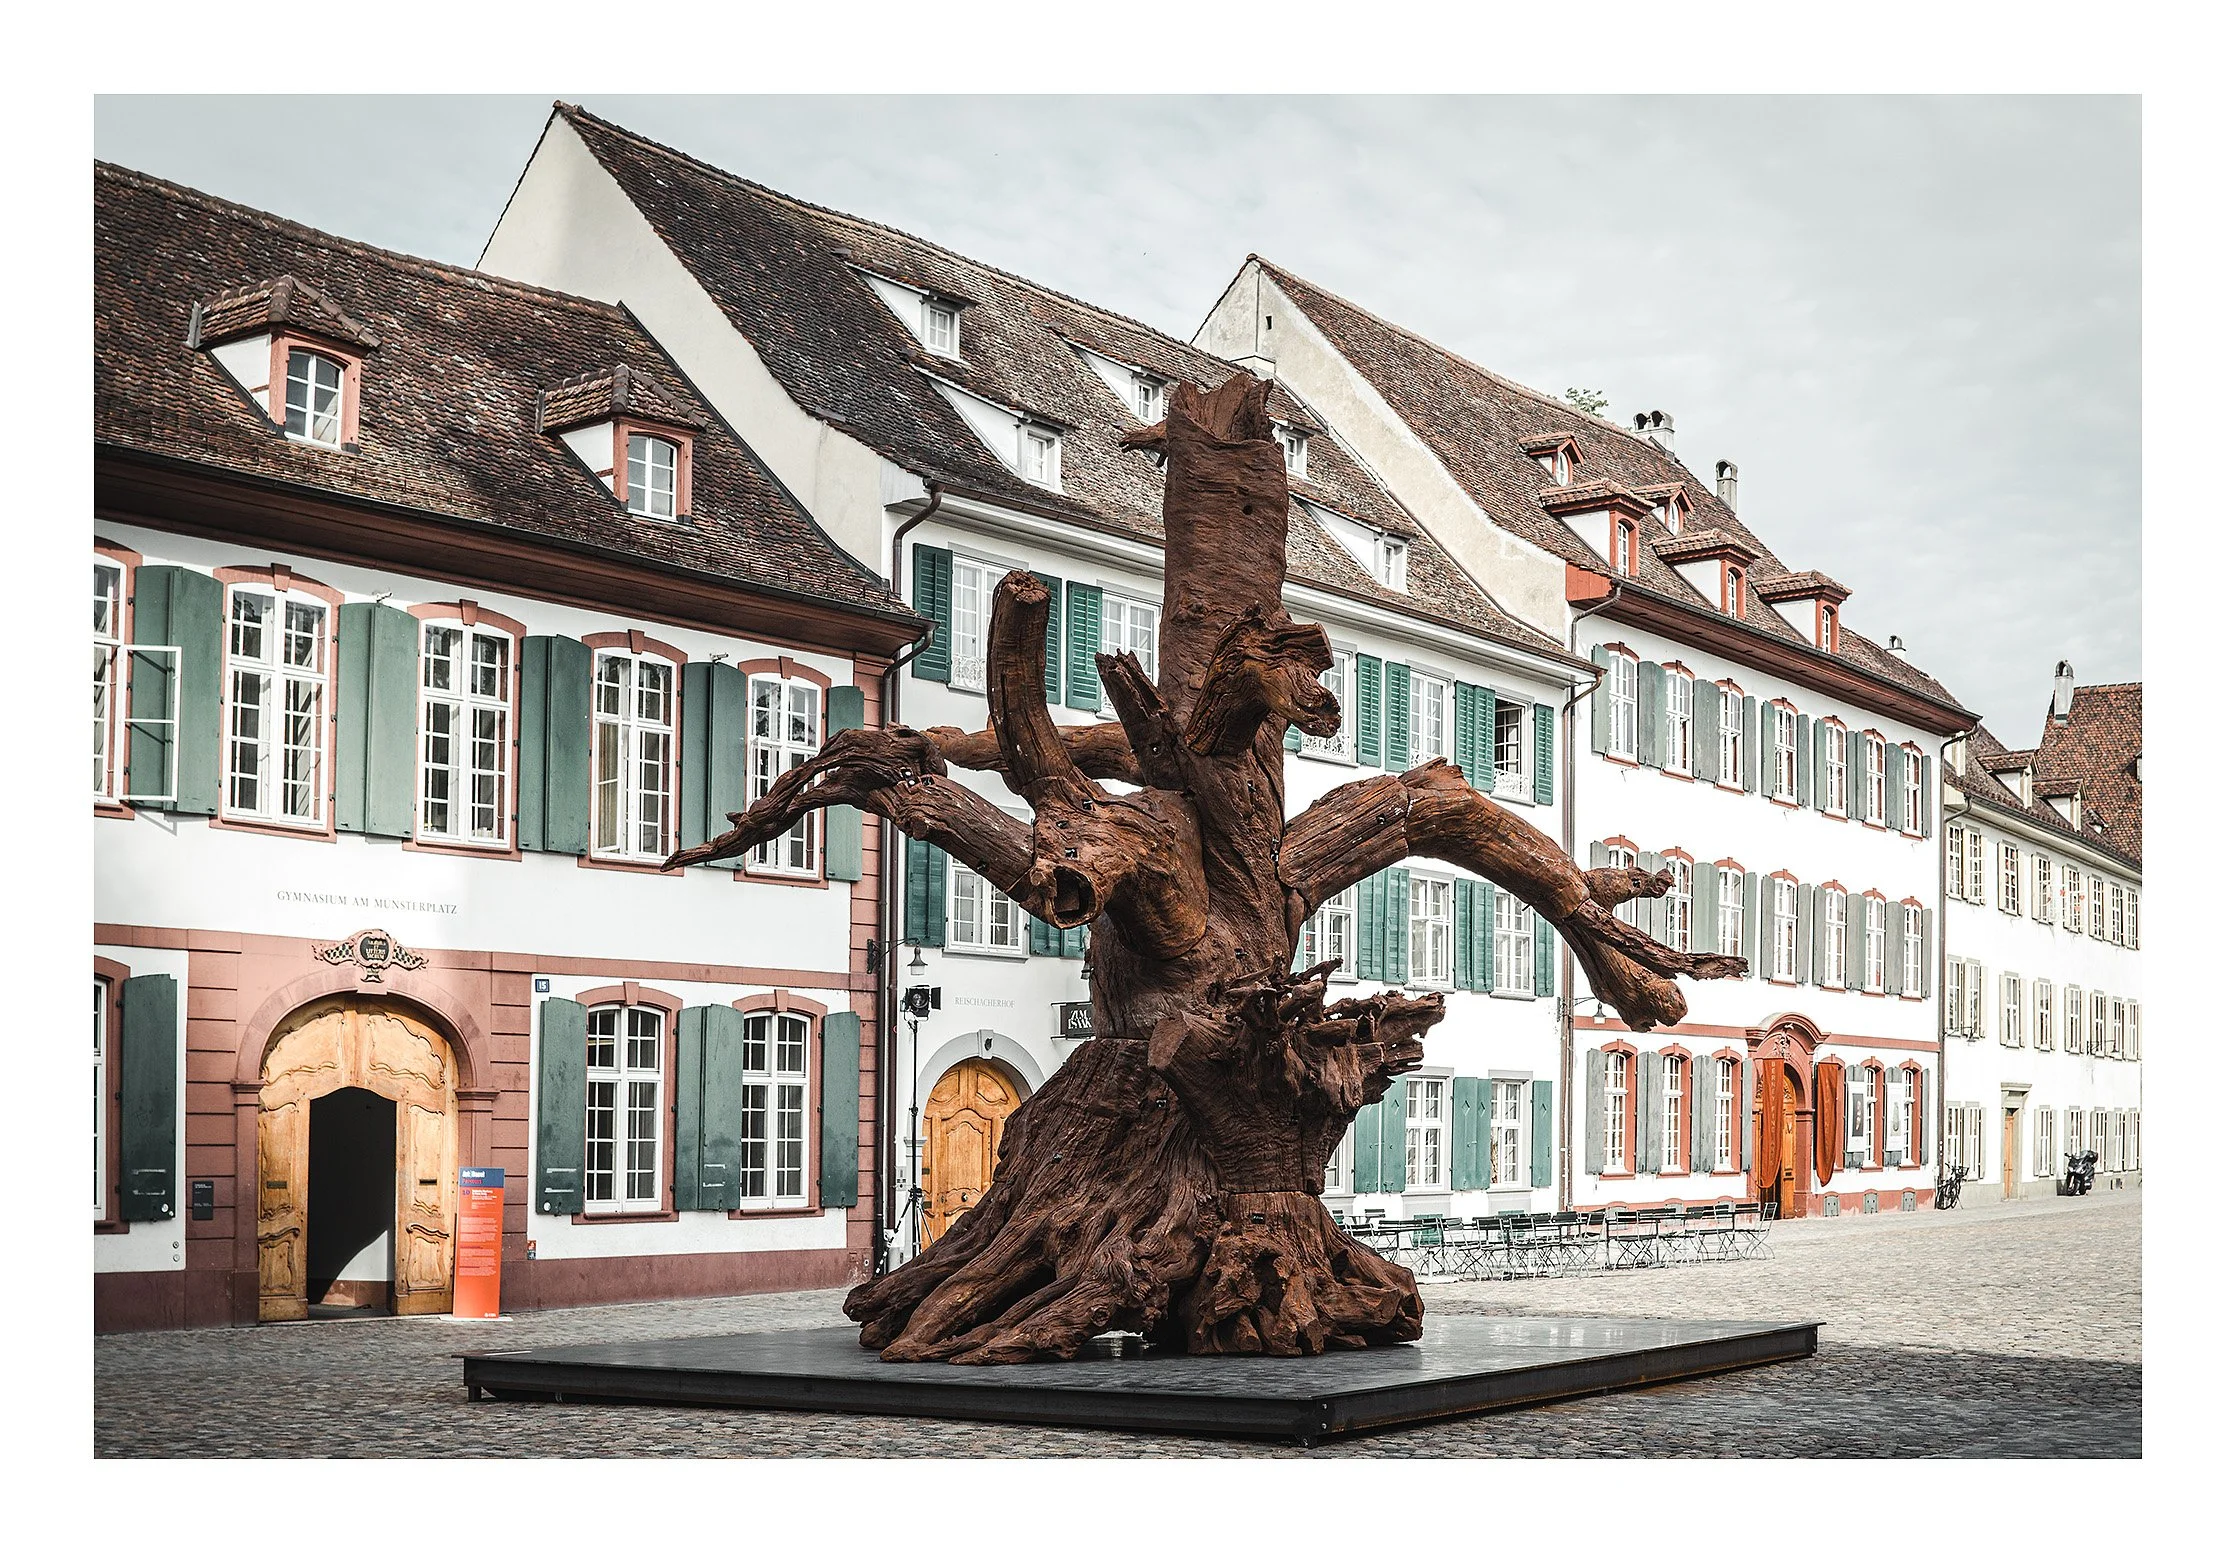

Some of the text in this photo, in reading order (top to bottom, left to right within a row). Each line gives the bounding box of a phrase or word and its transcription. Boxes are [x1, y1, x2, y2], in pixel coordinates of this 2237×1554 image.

[277, 891, 347, 905] GYMNASIUM
[352, 897, 369, 907] AM
[954, 997, 1015, 1009] REISCHACHERHOF
